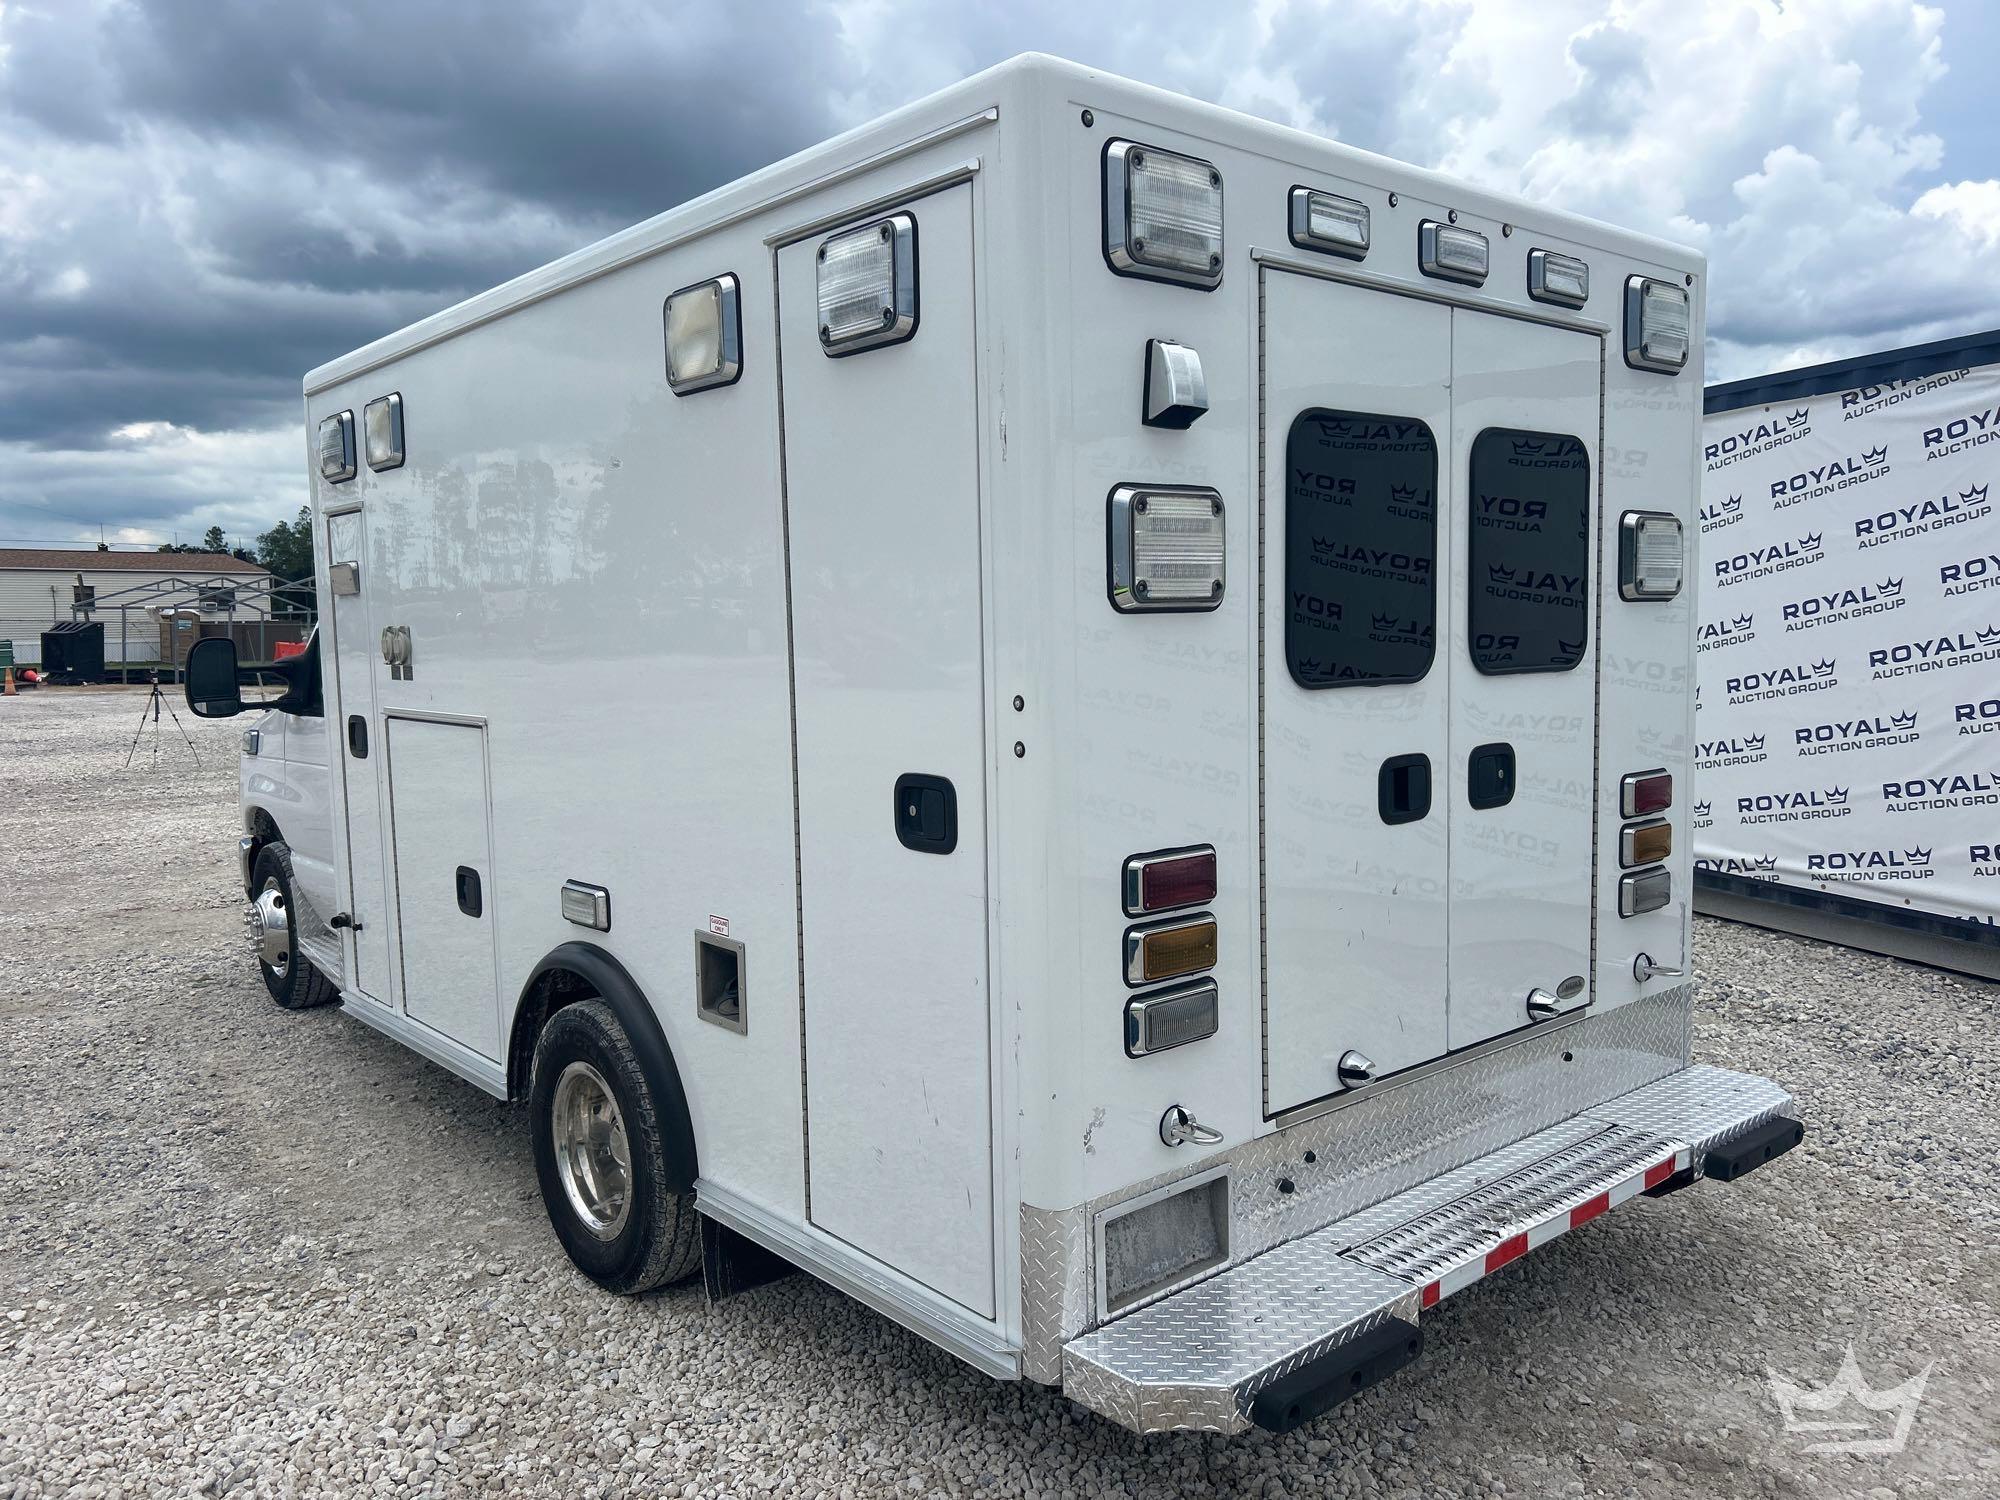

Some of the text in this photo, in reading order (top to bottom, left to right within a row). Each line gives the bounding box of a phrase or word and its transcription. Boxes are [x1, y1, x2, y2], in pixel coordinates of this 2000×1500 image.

[1844, 368, 1970, 421] AUCTION GROUP
[1704, 420, 1786, 461] ROYAL
[1707, 427, 1812, 472] AUCTION GROUP
[1770, 458, 1862, 498] ROYAL
[1773, 466, 1890, 510] AUCTION GROUP
[1702, 513, 1744, 533] GROUP
[1855, 496, 1960, 537] ROYAL
[1858, 506, 1992, 550] AUCTION GROUP
[1715, 541, 1798, 576] ROYAL
[1718, 552, 1824, 588] AUCTION GROUP
[1782, 586, 1876, 620] ROYAL
[1786, 598, 1906, 632] AUCTION GROUP
[1712, 632, 1755, 649] GROUP
[1869, 634, 1976, 668] ROYAL
[1726, 666, 1812, 694] ROYAL
[1872, 660, 1944, 680] AUCTION
[1728, 679, 1838, 706] AUCTION GROUP
[1796, 718, 1890, 744] ROYAL
[1798, 733, 1920, 756] AUCTION GROUP
[1724, 754, 1767, 766] GROUP
[1882, 774, 1990, 799] ROYAL
[1738, 791, 1824, 812] ROYAL
[1886, 798, 1958, 812] AUCTION
[1740, 808, 1851, 824] AUCTION GROUP
[1808, 850, 1904, 870] ROYAL
[1810, 869, 1934, 882] AUCTION GROUP
